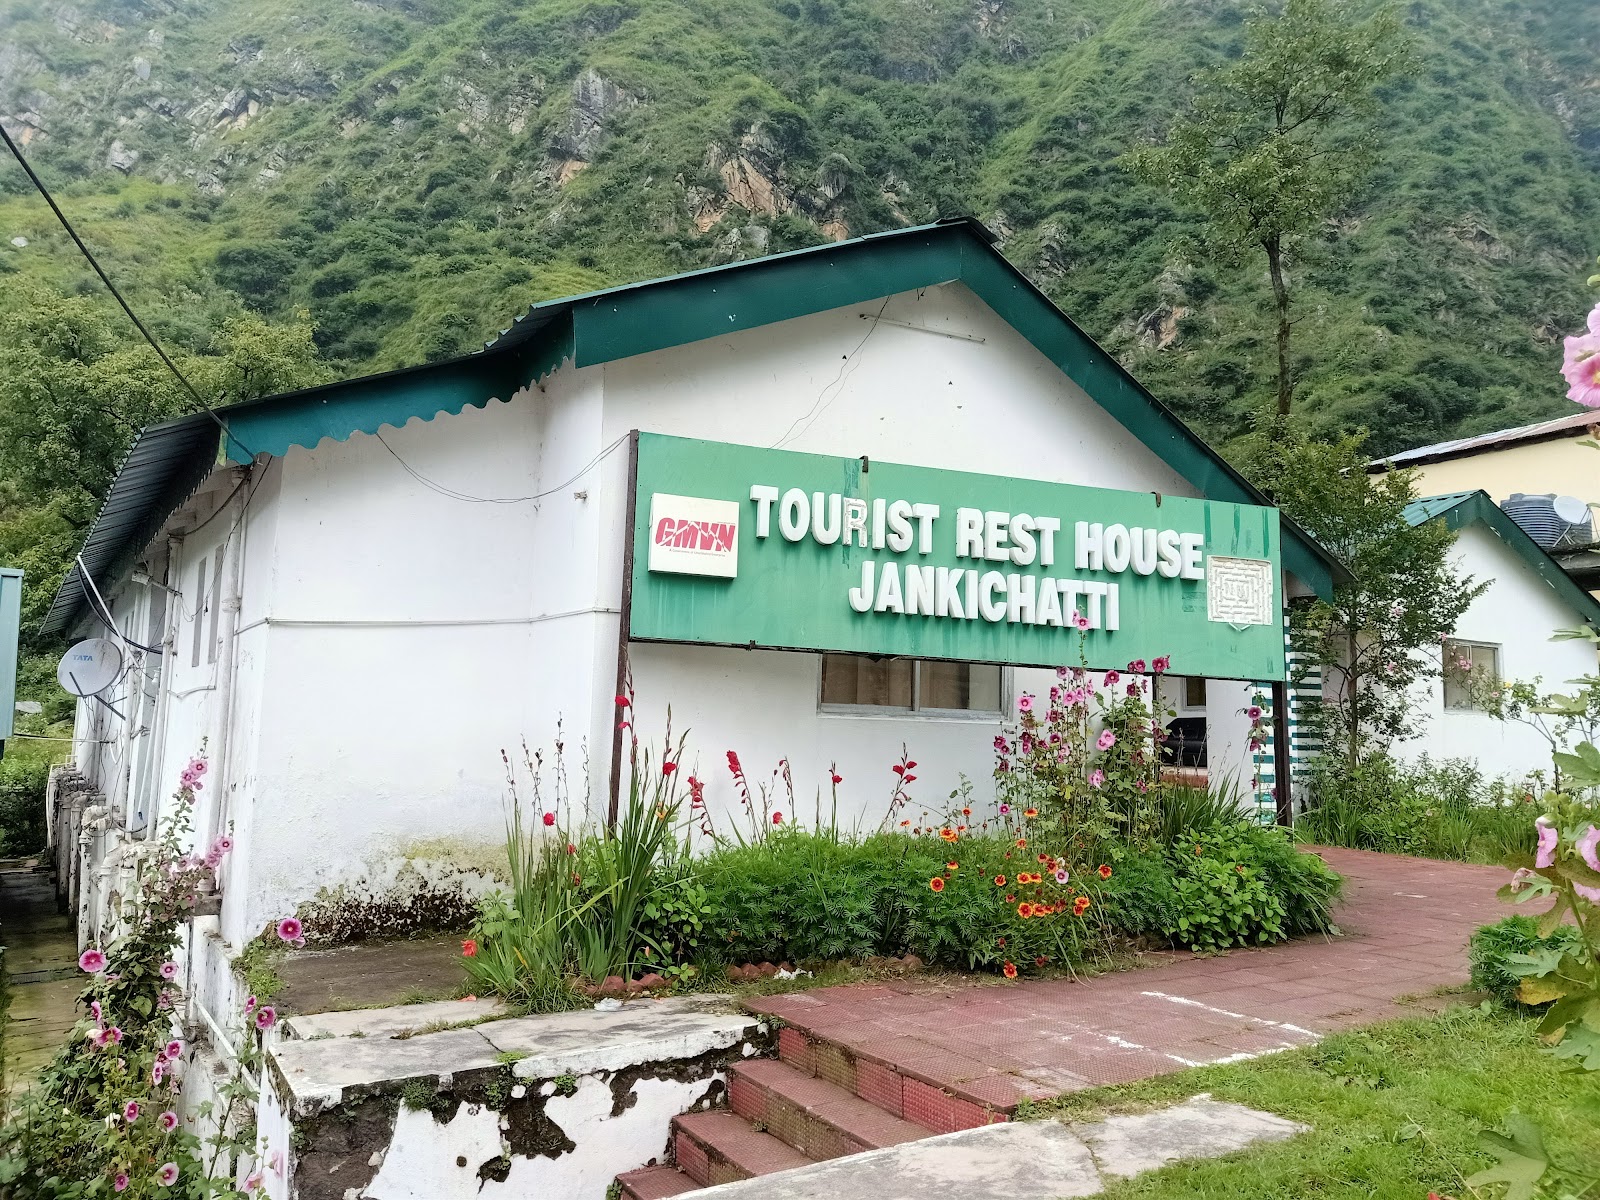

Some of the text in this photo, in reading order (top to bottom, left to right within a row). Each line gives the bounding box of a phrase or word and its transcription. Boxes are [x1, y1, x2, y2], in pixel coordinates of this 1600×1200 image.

[655, 517, 736, 552] GMVN
[750, 484, 1205, 580] TOURIST REST HOUSE
[848, 560, 1120, 632] JANKICHATTI
[73, 654, 93, 662] TATA
